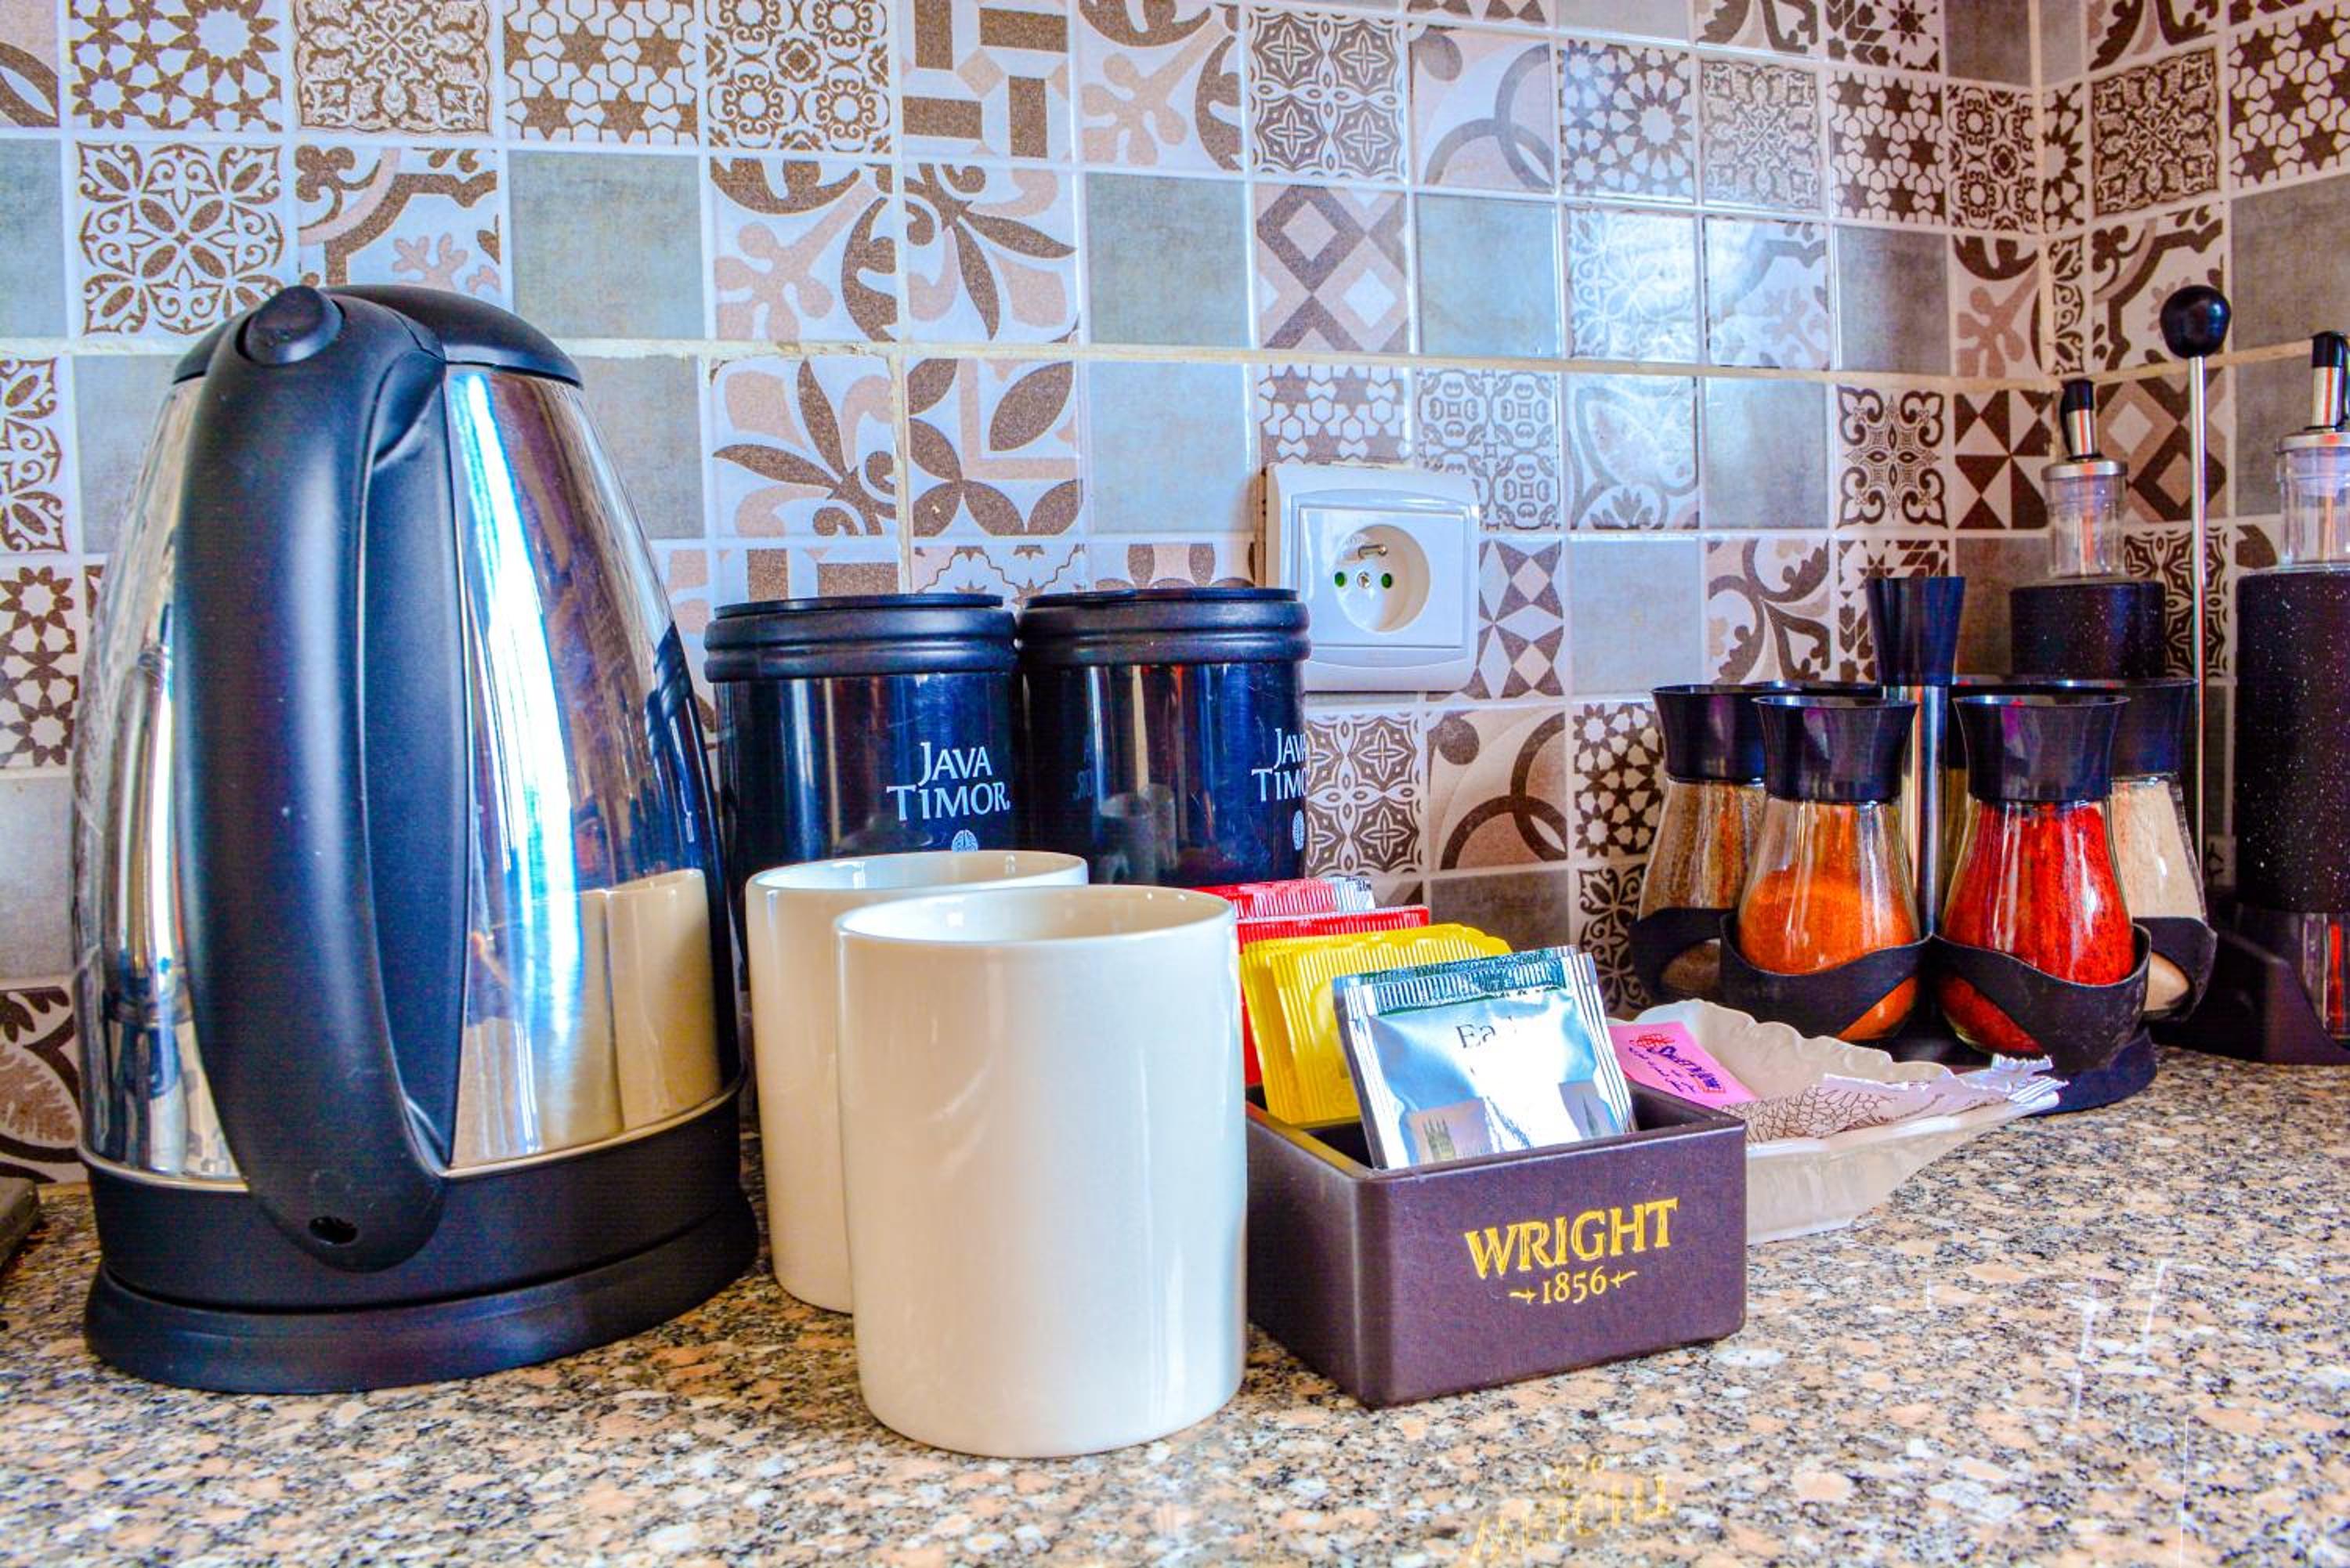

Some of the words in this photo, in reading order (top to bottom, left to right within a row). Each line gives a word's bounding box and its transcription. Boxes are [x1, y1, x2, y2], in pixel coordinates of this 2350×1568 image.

[918, 742, 993, 787] JAVA
[886, 781, 1011, 822] TIMOR
[1464, 1198, 1679, 1279] WRIGHT
[1542, 1265, 1607, 1305] 1856
